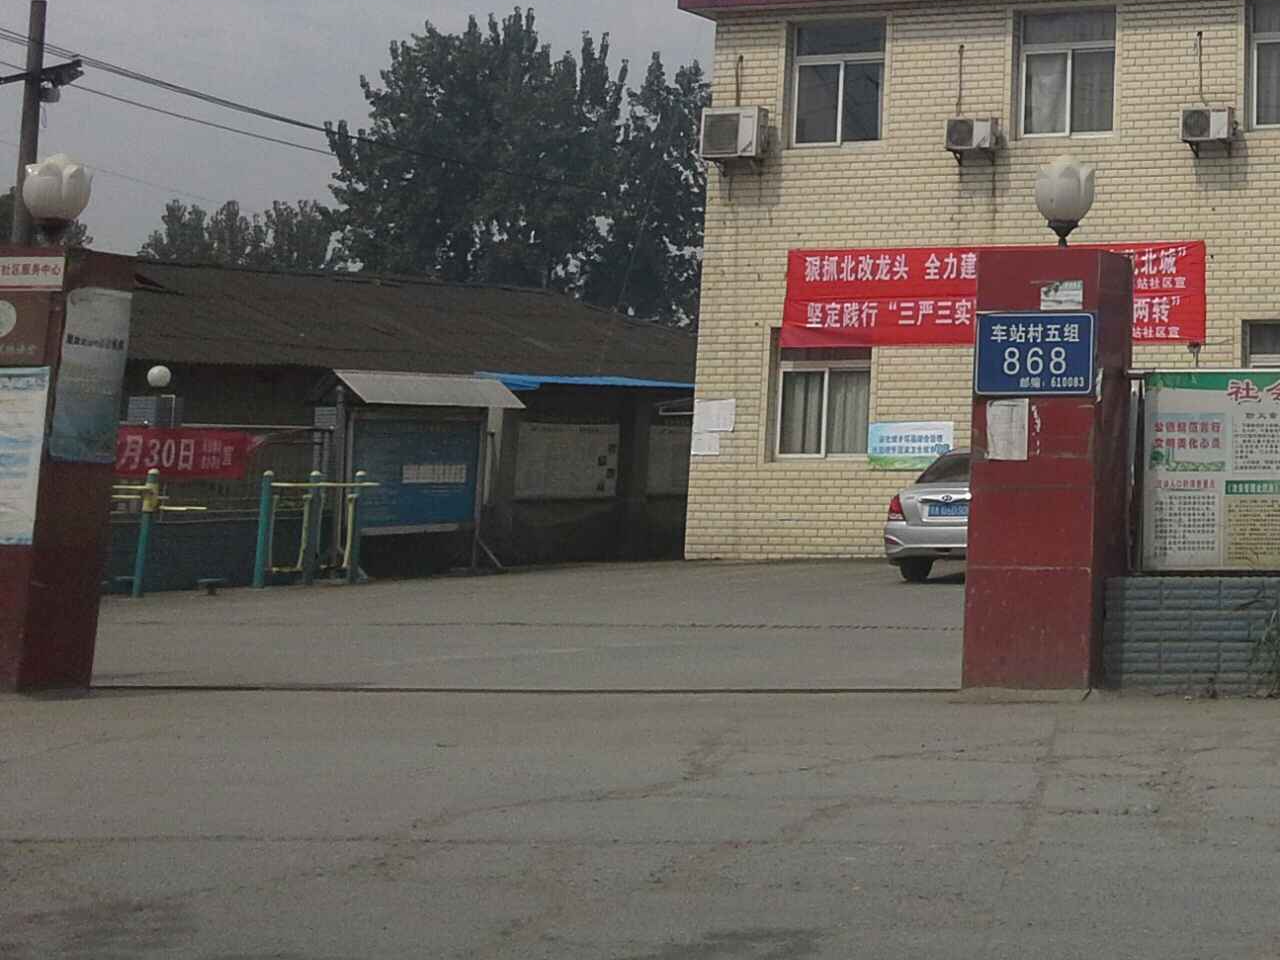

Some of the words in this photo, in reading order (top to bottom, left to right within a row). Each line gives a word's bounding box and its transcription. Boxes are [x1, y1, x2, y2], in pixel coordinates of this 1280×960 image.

[804, 254, 909, 283] 狠抓北改龙头
[924, 252, 977, 281] 全力建
[1134, 246, 1187, 275] 北城”
[806, 302, 878, 328] 坚定践行
[990, 323, 1081, 342] 车站村五组
[1003, 347, 1067, 375] 868
